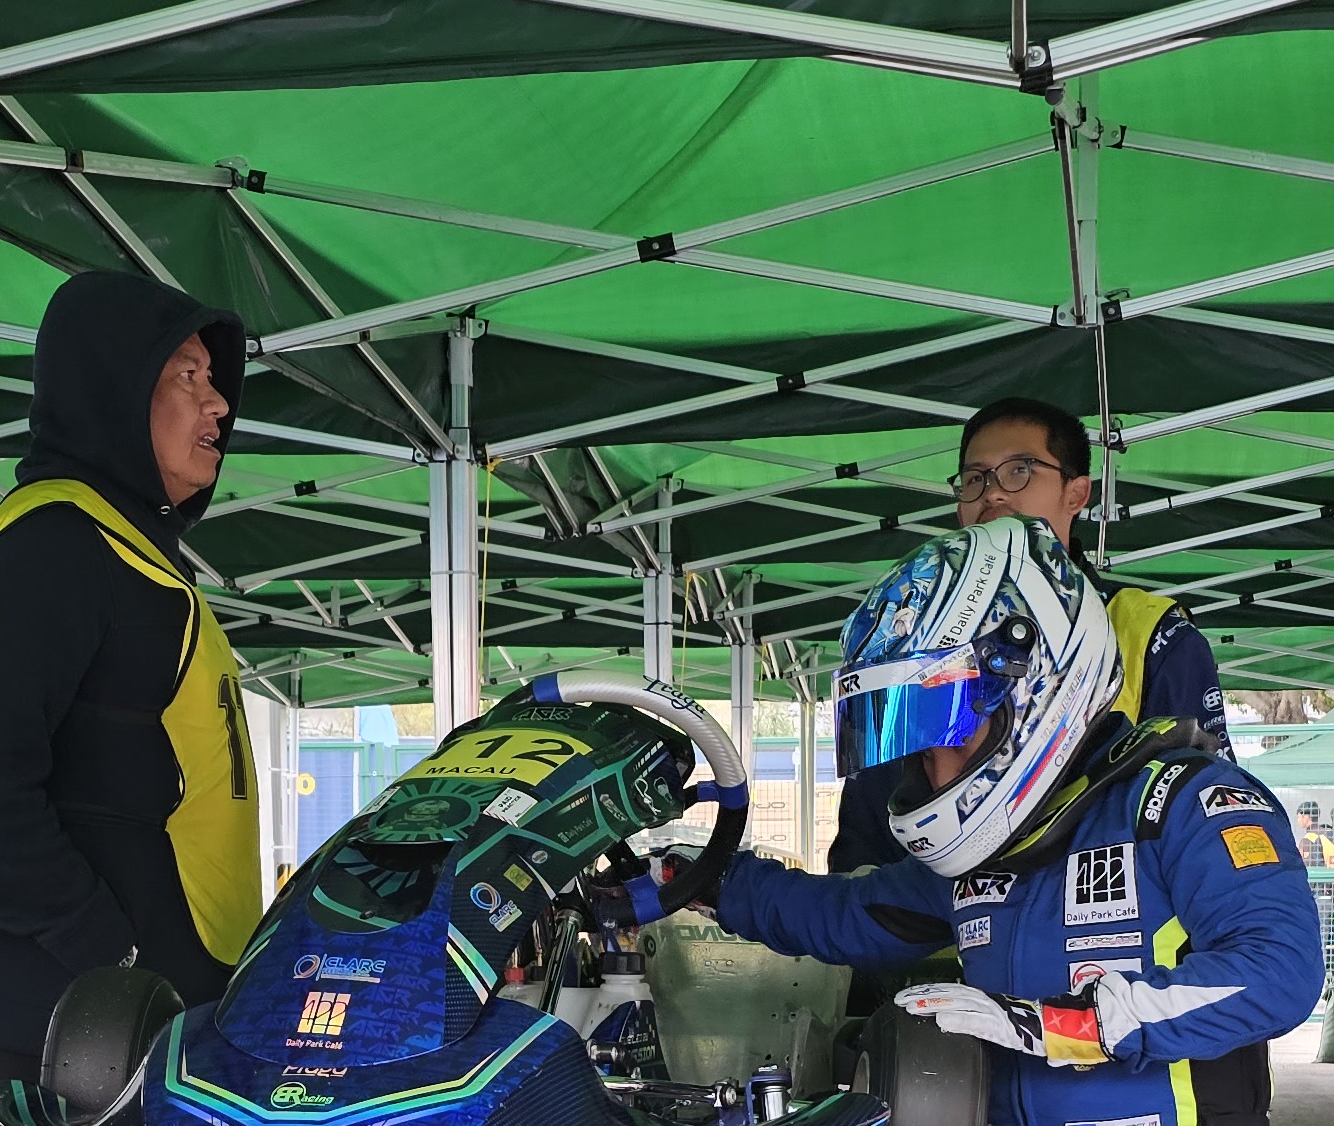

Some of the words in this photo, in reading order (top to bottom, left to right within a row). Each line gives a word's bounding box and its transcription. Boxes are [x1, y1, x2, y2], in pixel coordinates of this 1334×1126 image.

[950, 604, 976, 636] Daily
[967, 577, 988, 604] Park
[979, 553, 997, 575] Café
[425, 764, 517, 776] MACAU
[1144, 763, 1188, 824] sparco
[1067, 913, 1088, 922] Daily
[1091, 910, 1113, 919] Park
[1115, 905, 1136, 917] Café
[324, 956, 387, 974] CLARC
[285, 1038, 304, 1048] Daily
[305, 1039, 324, 1048] Park
[325, 1040, 343, 1049] Café
